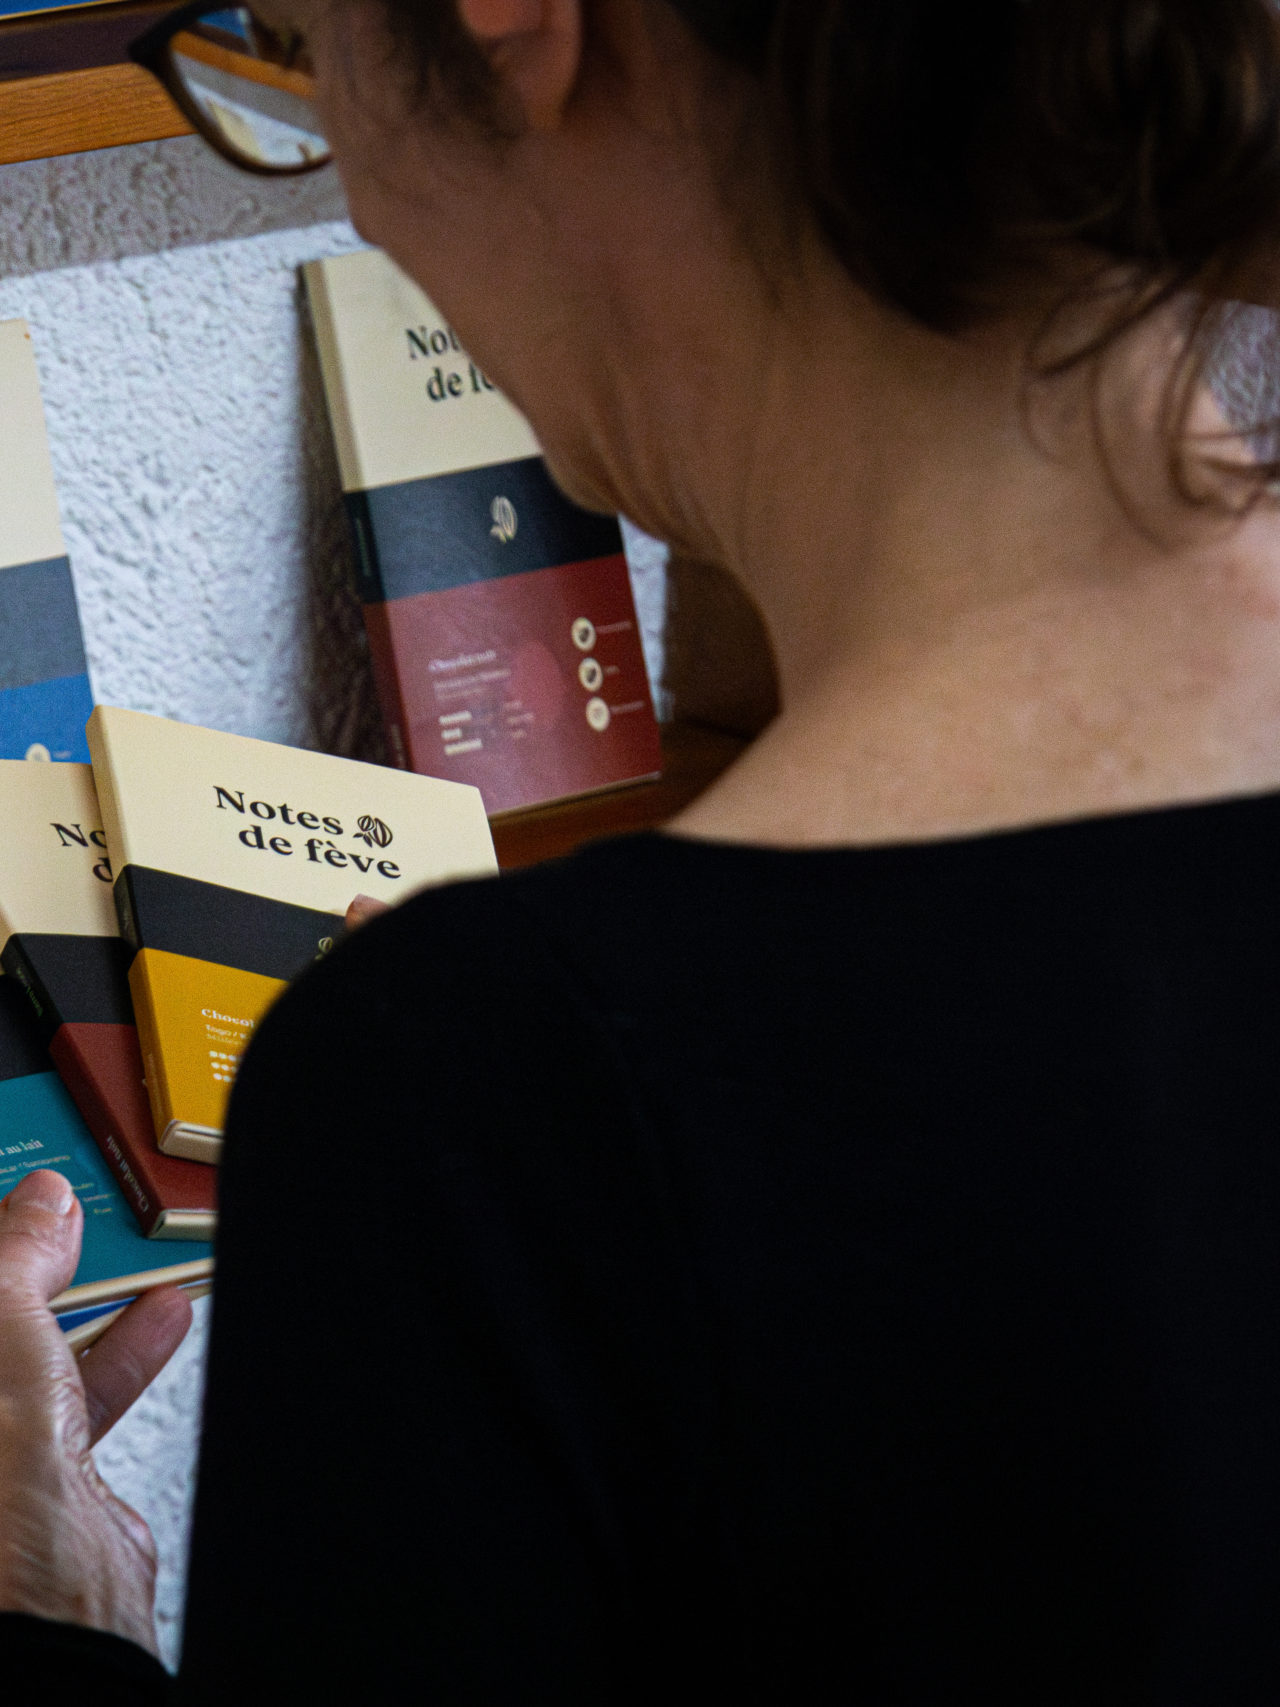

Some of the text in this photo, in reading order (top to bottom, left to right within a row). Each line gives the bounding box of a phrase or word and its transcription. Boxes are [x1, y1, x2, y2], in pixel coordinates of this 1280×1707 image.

[406, 324, 460, 360] Not
[426, 367, 463, 402] de
[213, 785, 344, 836] Notes
[239, 824, 402, 879] de fève
[201, 1008, 254, 1028] Chocol
[7, 1144, 21, 1155] au
[21, 1138, 44, 1151] lait
